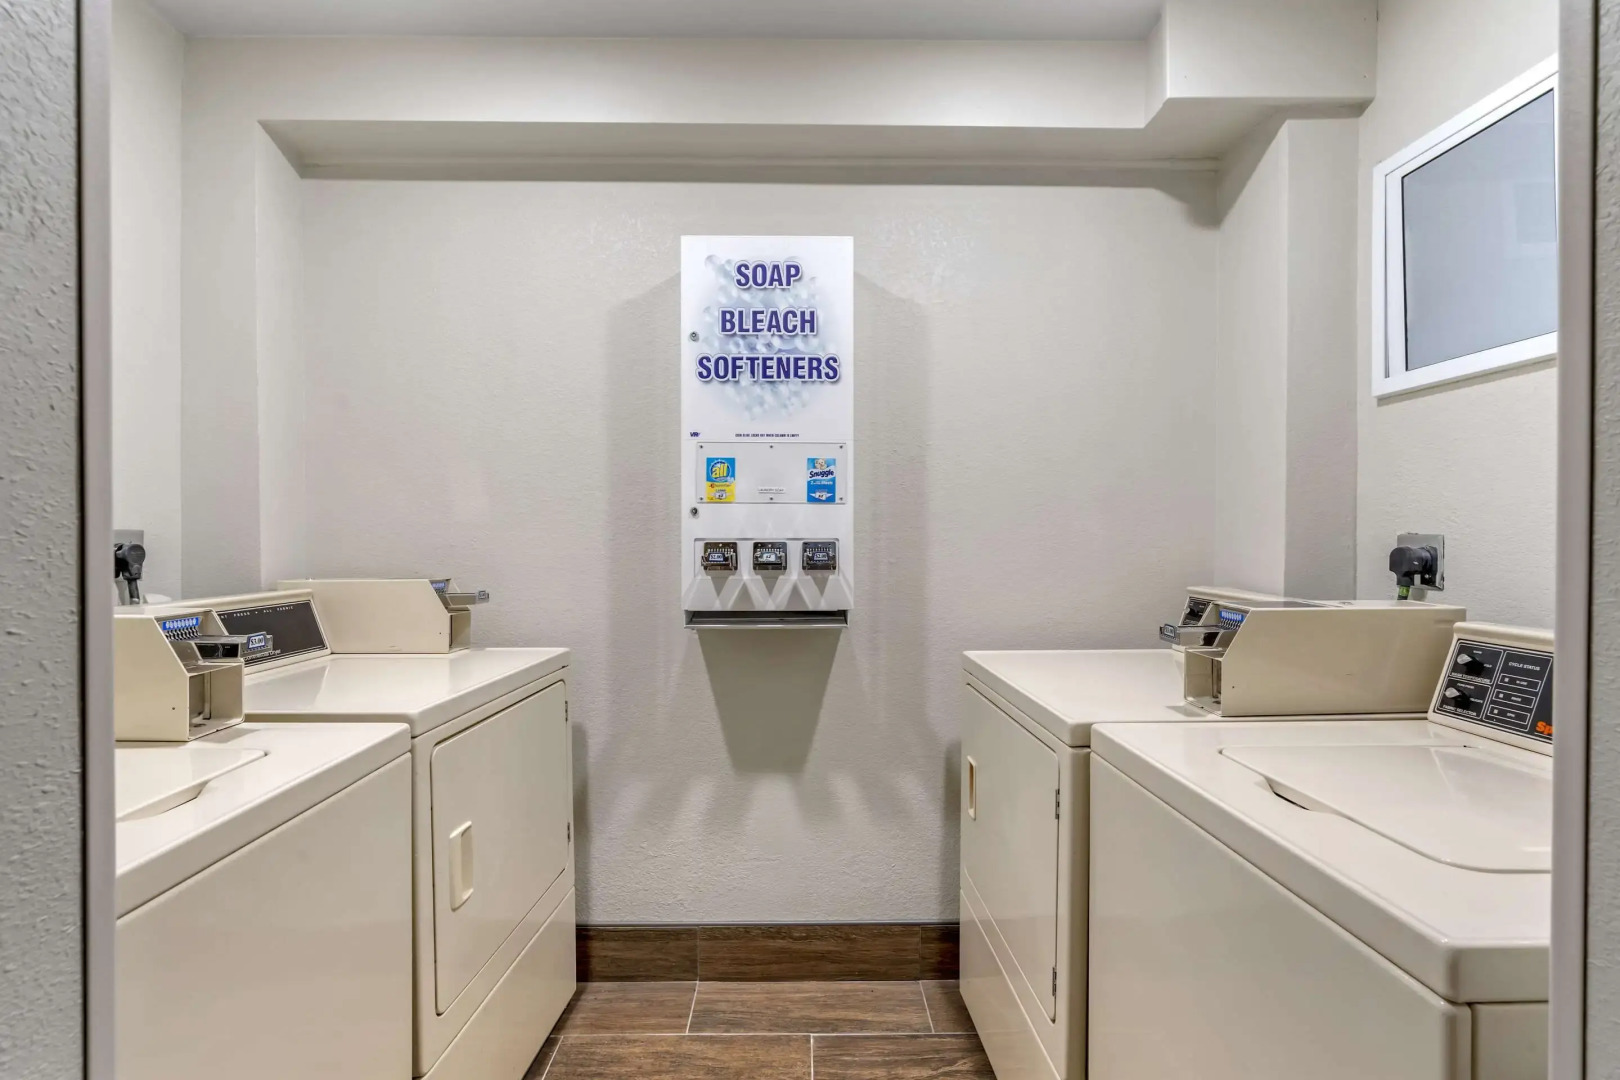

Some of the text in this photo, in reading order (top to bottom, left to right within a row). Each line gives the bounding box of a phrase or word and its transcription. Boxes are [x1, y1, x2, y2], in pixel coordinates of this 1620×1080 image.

[735, 262, 801, 288] SOAP
[720, 309, 816, 334] BLEACH
[697, 355, 839, 380] SOFTENERS
[712, 463, 728, 478] all
[809, 469, 834, 479] Snuggle
